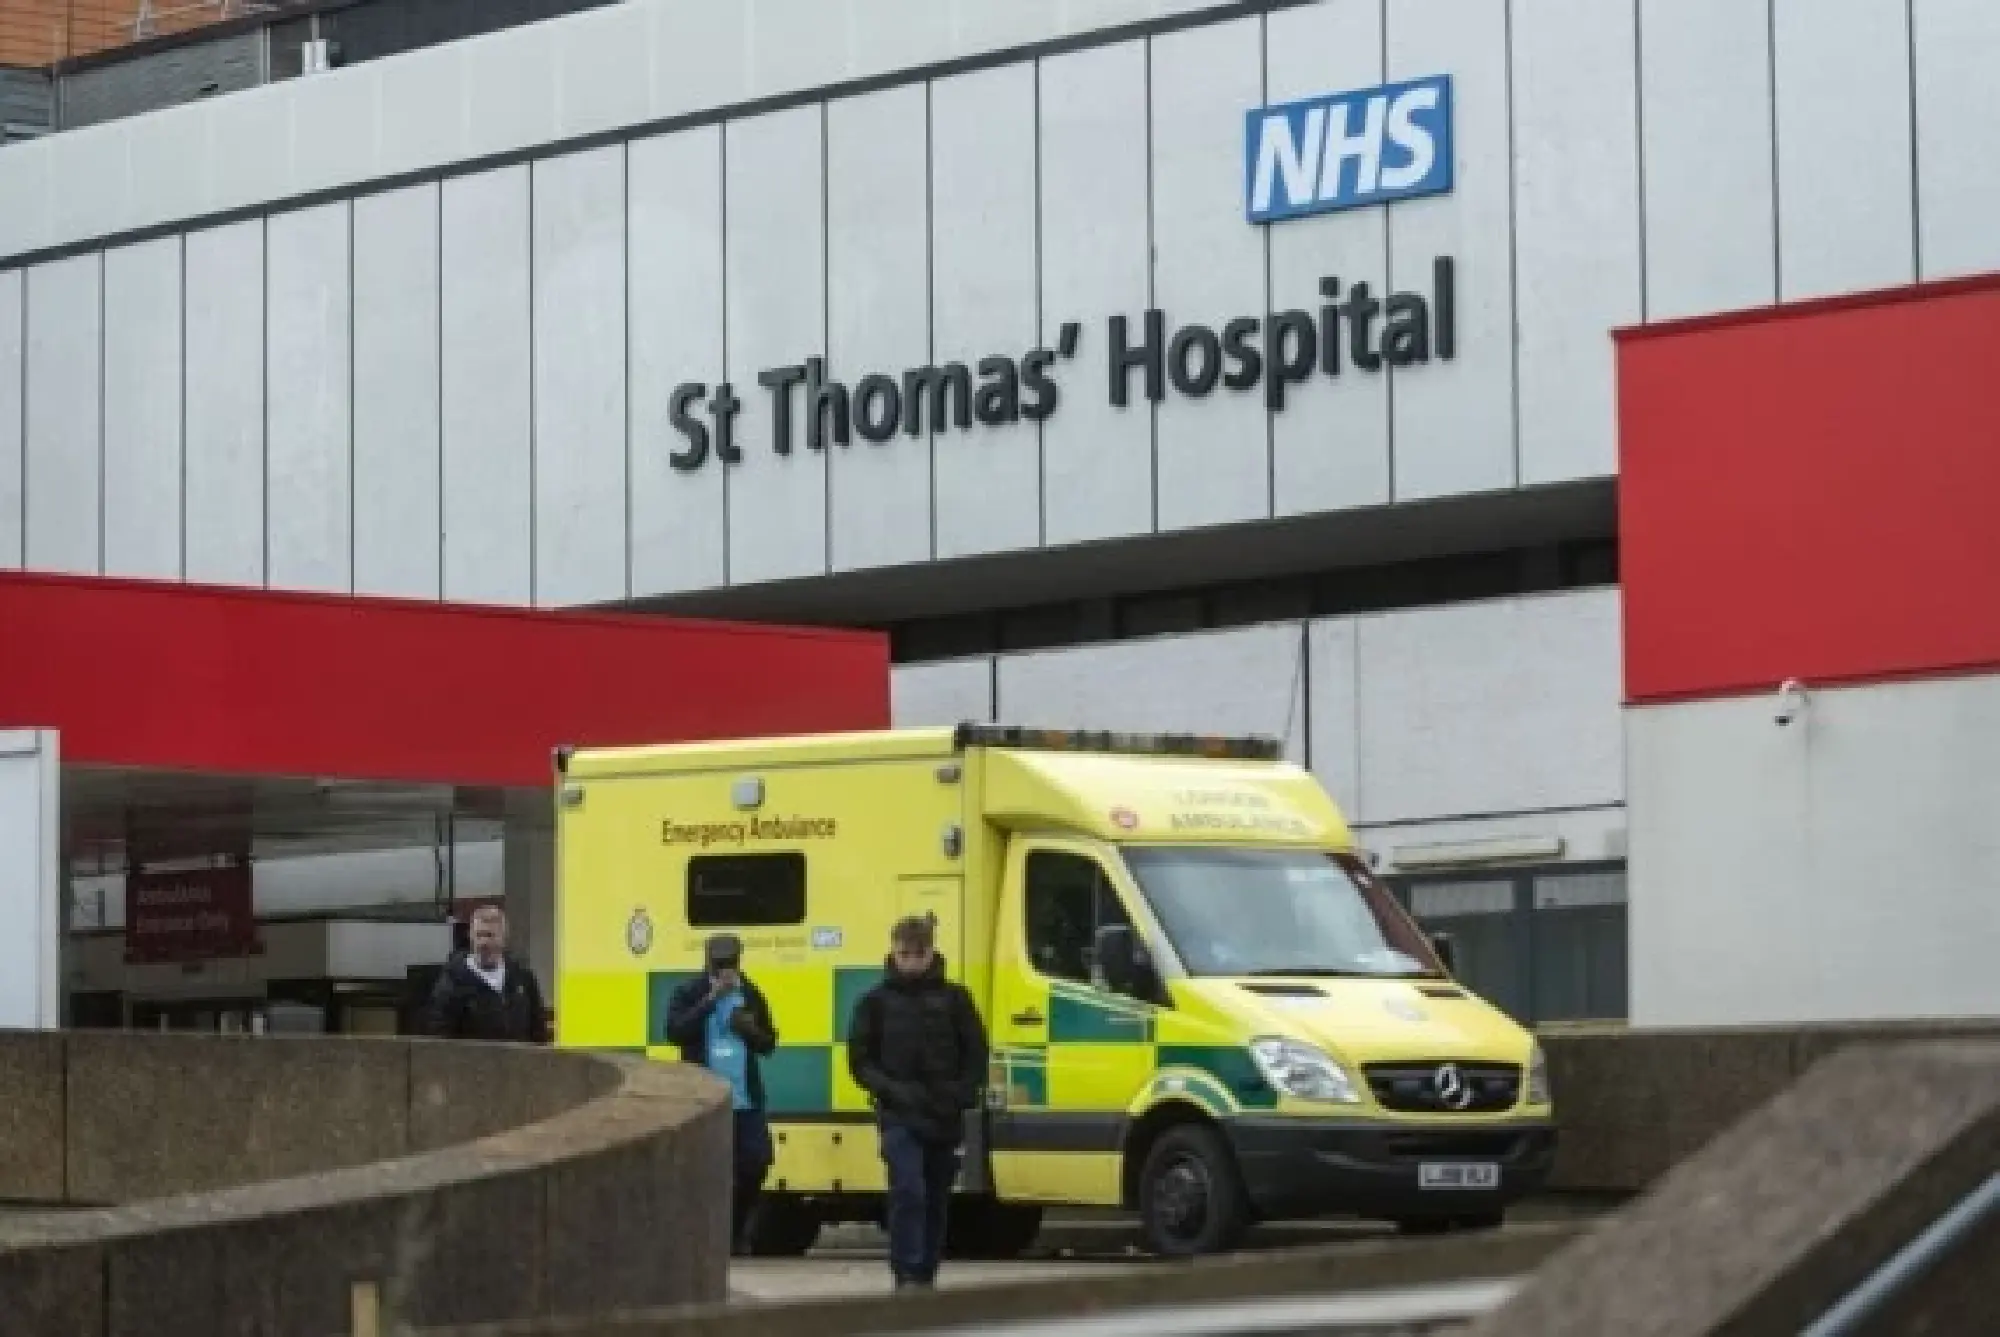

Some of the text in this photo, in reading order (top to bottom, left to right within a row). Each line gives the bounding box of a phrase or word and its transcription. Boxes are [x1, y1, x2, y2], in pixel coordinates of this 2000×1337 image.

[1252, 87, 1438, 211] NHS
[669, 381, 743, 469] St
[1108, 255, 1455, 413] Hospital
[662, 815, 836, 848] Emergency Ambulance
